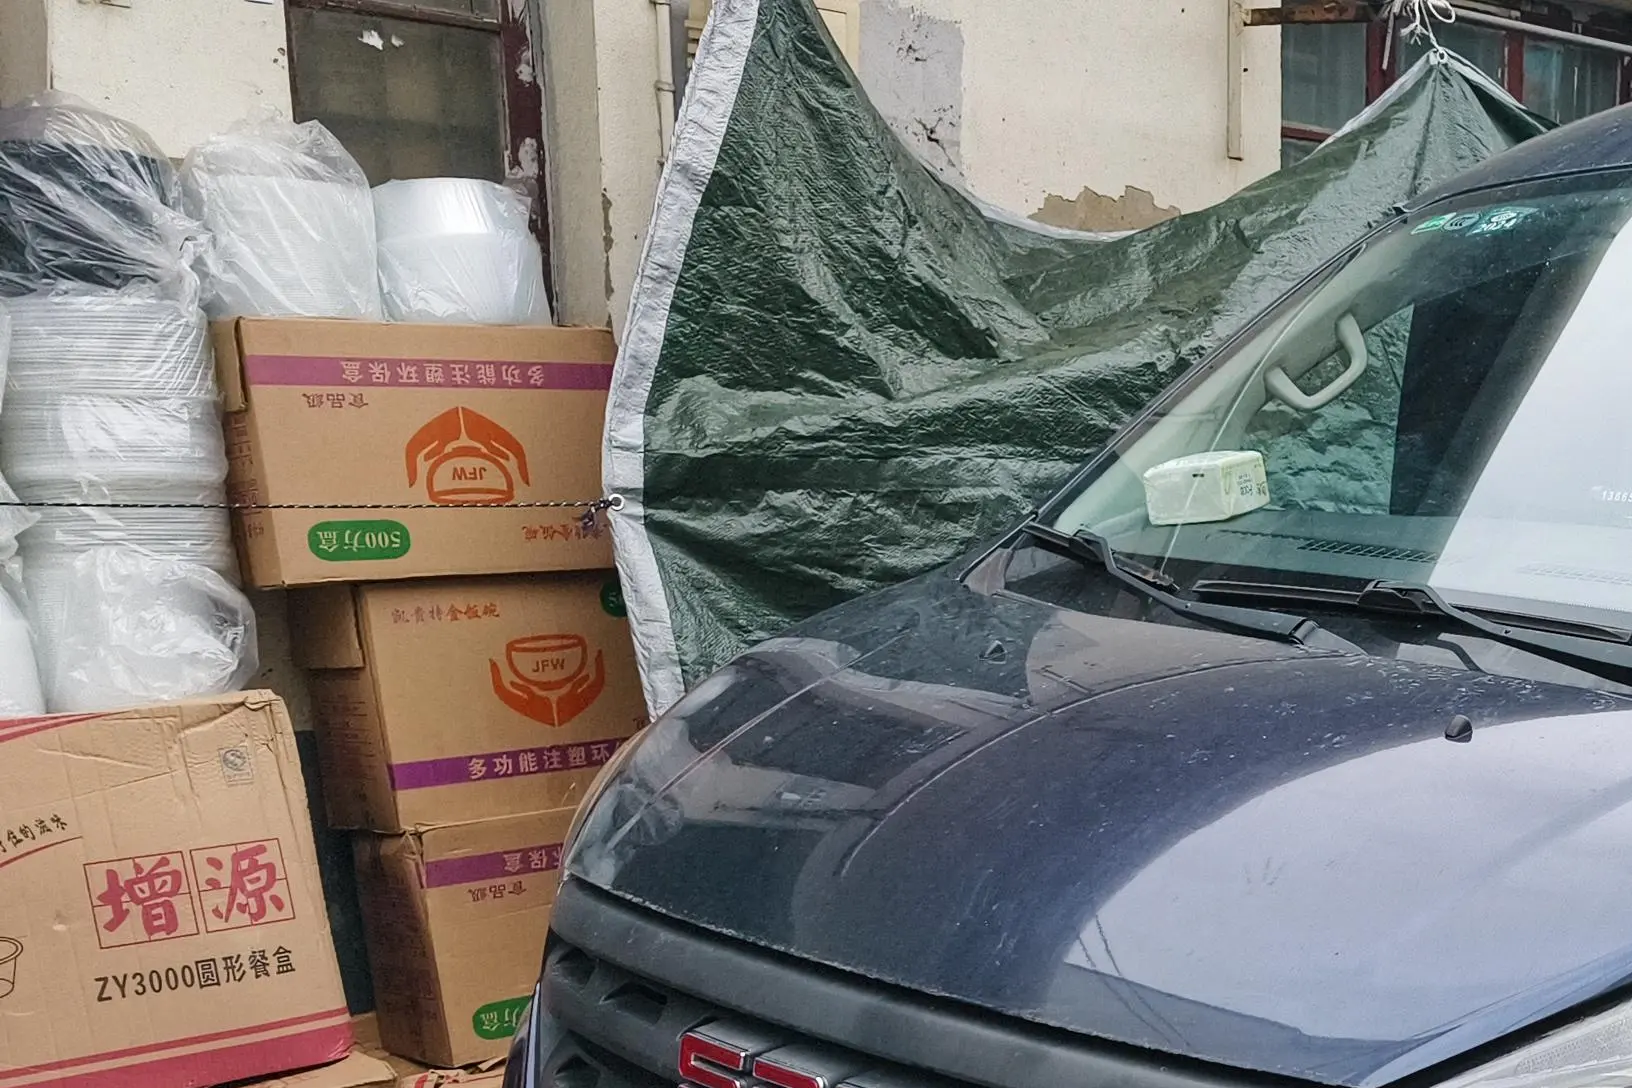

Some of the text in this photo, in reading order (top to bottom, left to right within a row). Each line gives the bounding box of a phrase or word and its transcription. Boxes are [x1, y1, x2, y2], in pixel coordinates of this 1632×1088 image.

[340, 360, 545, 386] 多功能注塑环保盒
[301, 392, 368, 410] 食品级
[451, 465, 488, 482] JFW
[316, 528, 402, 553] 500方盒
[531, 657, 566, 675] JFW
[96, 843, 284, 938] 增源
[468, 881, 528, 903] 食品级
[94, 945, 297, 1003] ZY3000圆形餐盒
